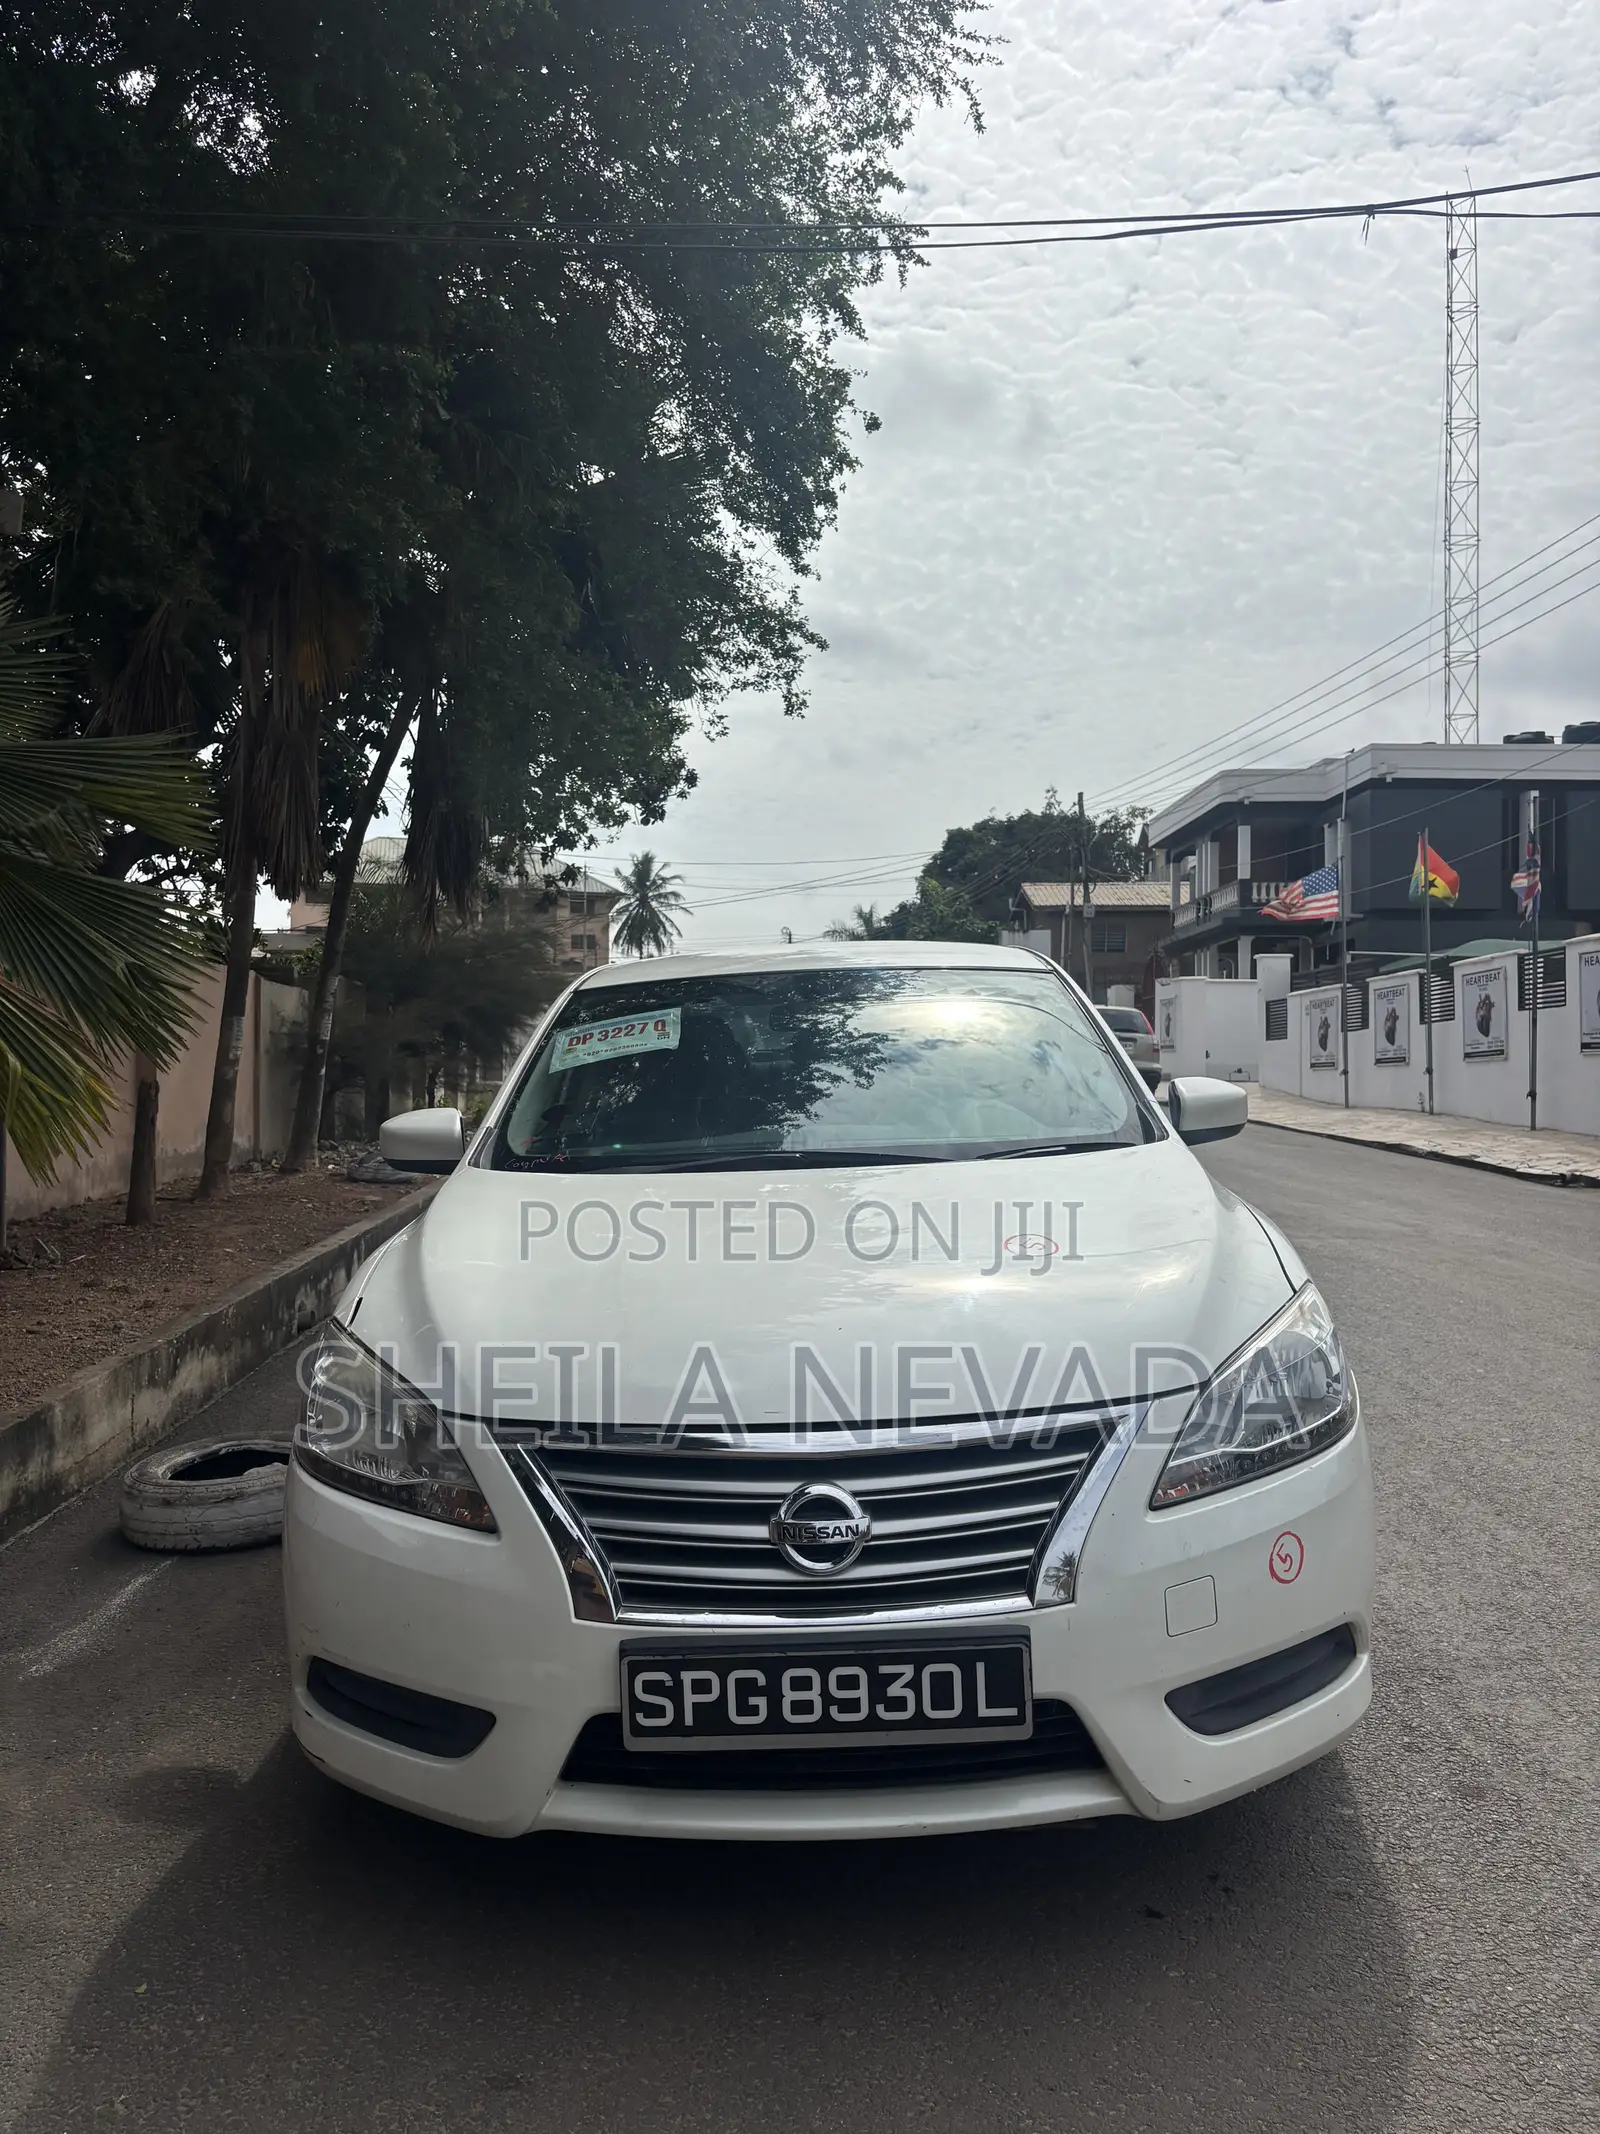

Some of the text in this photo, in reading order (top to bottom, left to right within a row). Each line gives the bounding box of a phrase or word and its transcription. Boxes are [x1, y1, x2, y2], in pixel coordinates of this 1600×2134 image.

[1465, 972, 1501, 986] HEARTBEAT
[1377, 988, 1405, 1000] HEARTBEAT
[567, 1032, 594, 1048] DP
[597, 1021, 649, 1042] 3227
[781, 1523, 860, 1540] NISSAN
[633, 1661, 1019, 1728] SPG8930L
